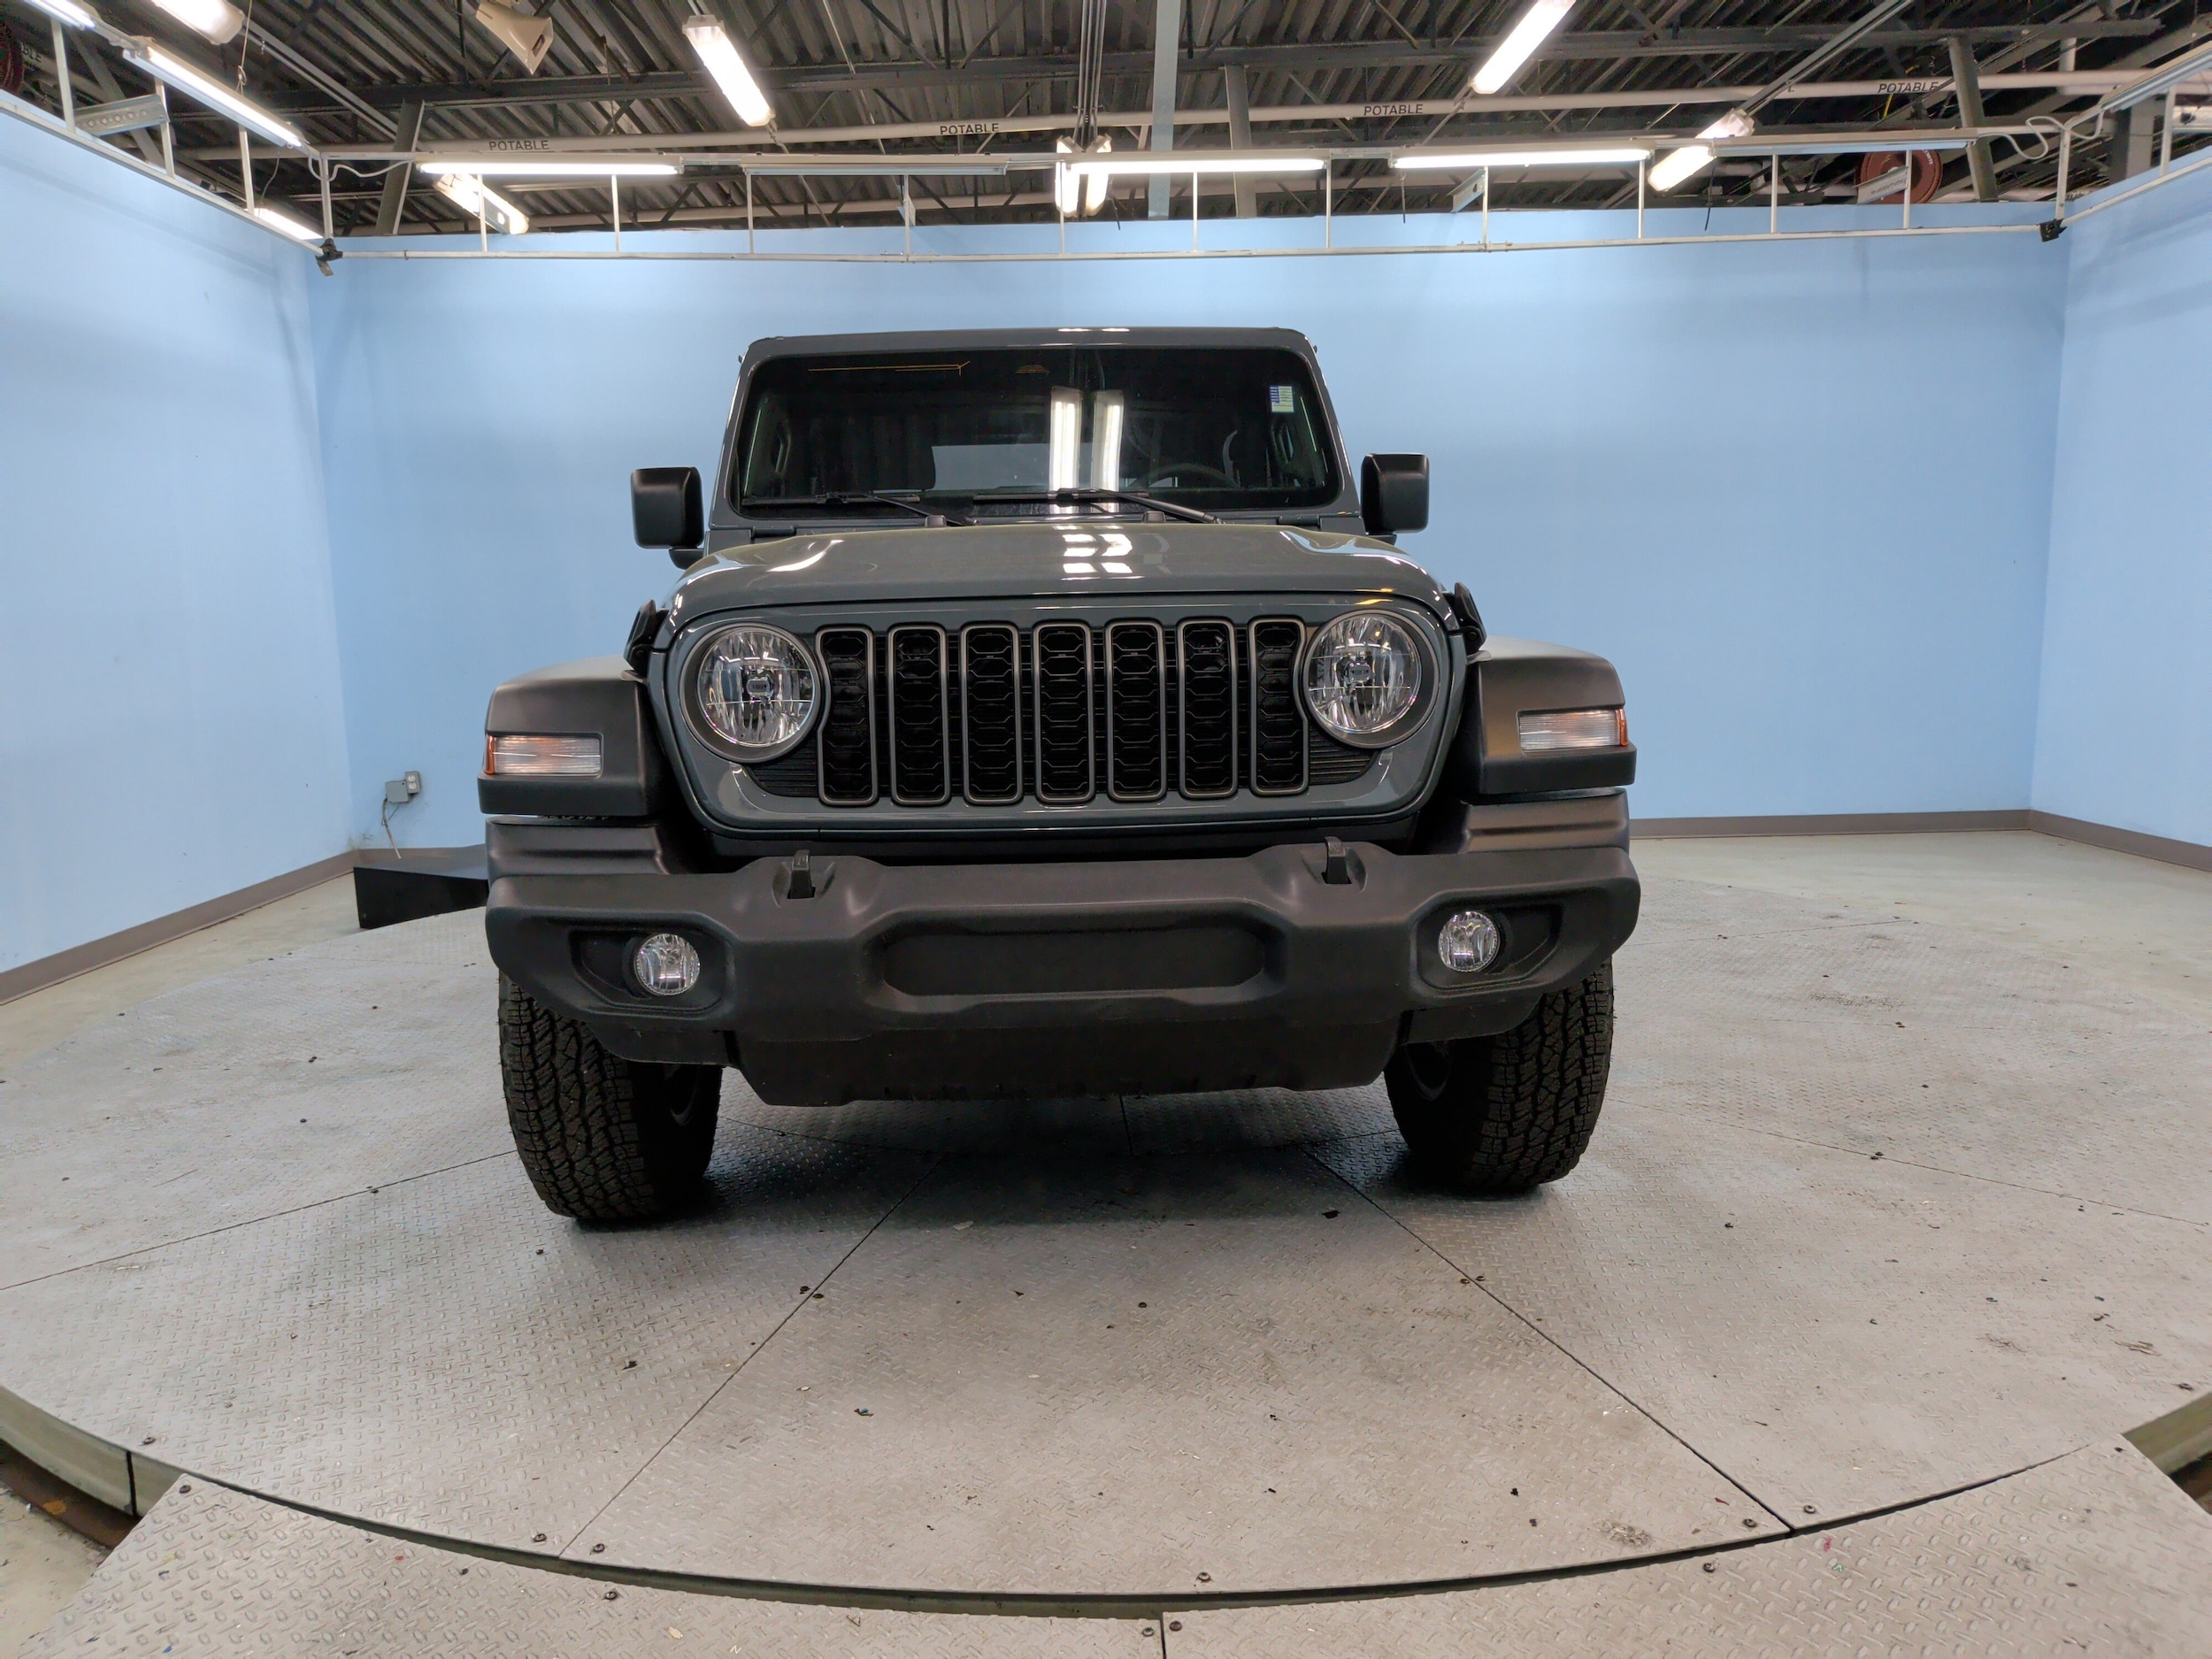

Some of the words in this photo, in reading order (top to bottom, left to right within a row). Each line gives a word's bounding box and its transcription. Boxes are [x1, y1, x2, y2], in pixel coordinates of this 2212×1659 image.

[1878, 81, 1939, 94] POTABLE
[1363, 104, 1424, 116] POTABLE
[940, 123, 1000, 135] POTABLE
[488, 140, 550, 151] POTABLE
